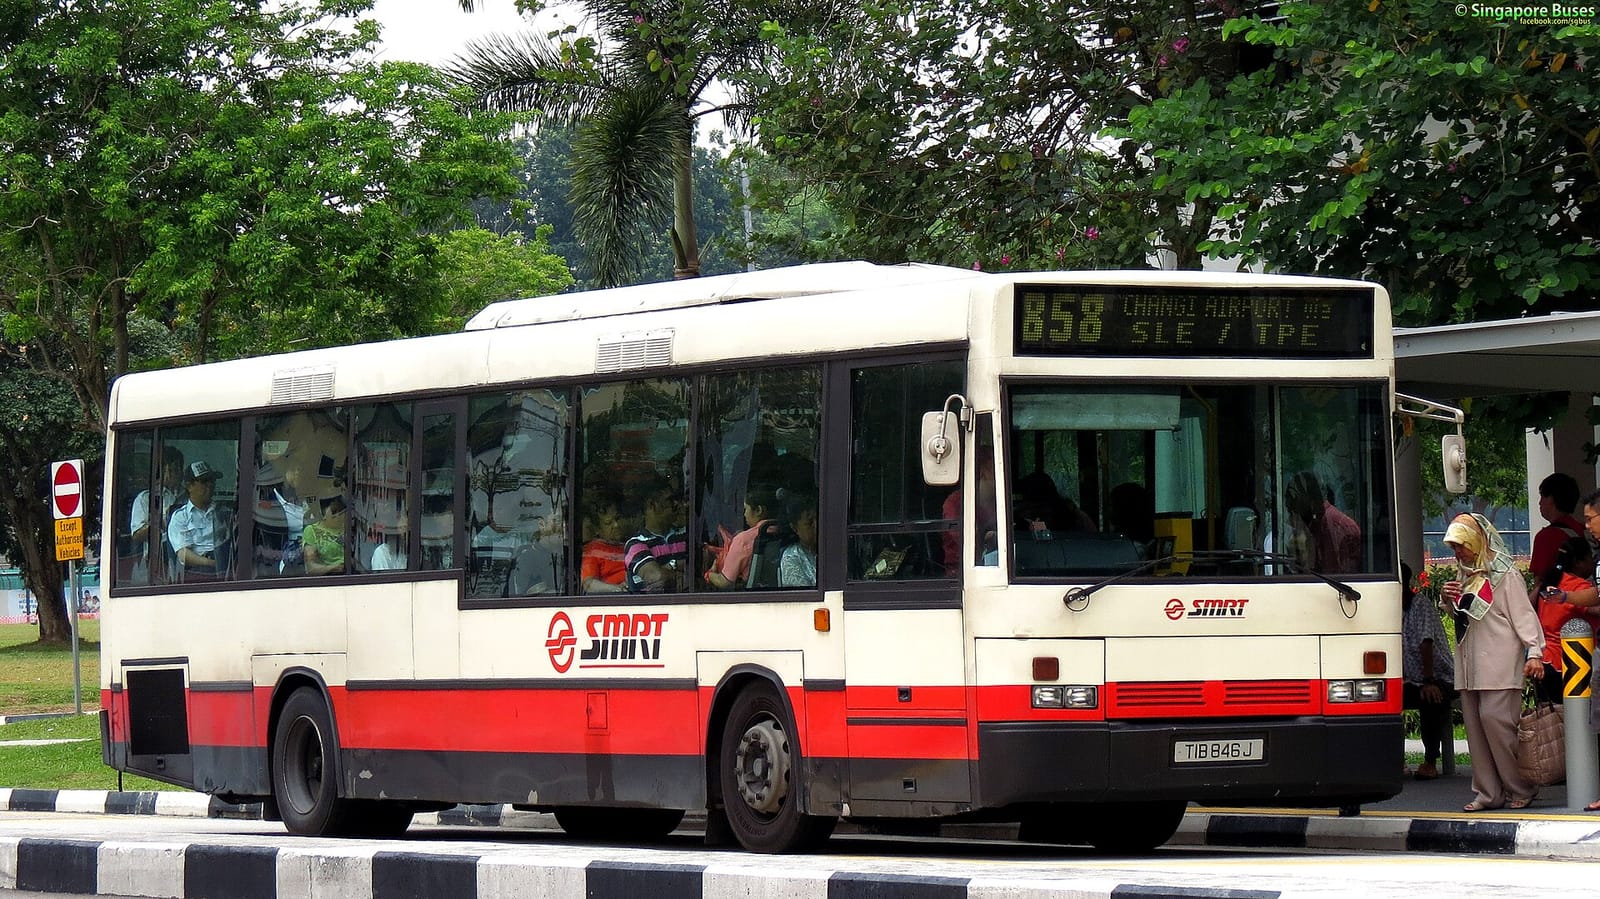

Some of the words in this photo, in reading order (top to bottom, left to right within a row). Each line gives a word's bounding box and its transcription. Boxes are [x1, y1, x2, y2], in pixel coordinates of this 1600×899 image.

[1022, 292, 1104, 342] 858
[1123, 294, 1198, 317] CHANGI
[1203, 295, 1296, 319] AIRPORT
[1131, 321, 1195, 344] SLE
[1256, 323, 1319, 346] TPE
[60, 520, 77, 534] Except
[56, 534, 82, 545] Authorised
[60, 547, 80, 559] Vehicles
[1187, 599, 1249, 616] SMRT
[580, 613, 669, 660] SMRT
